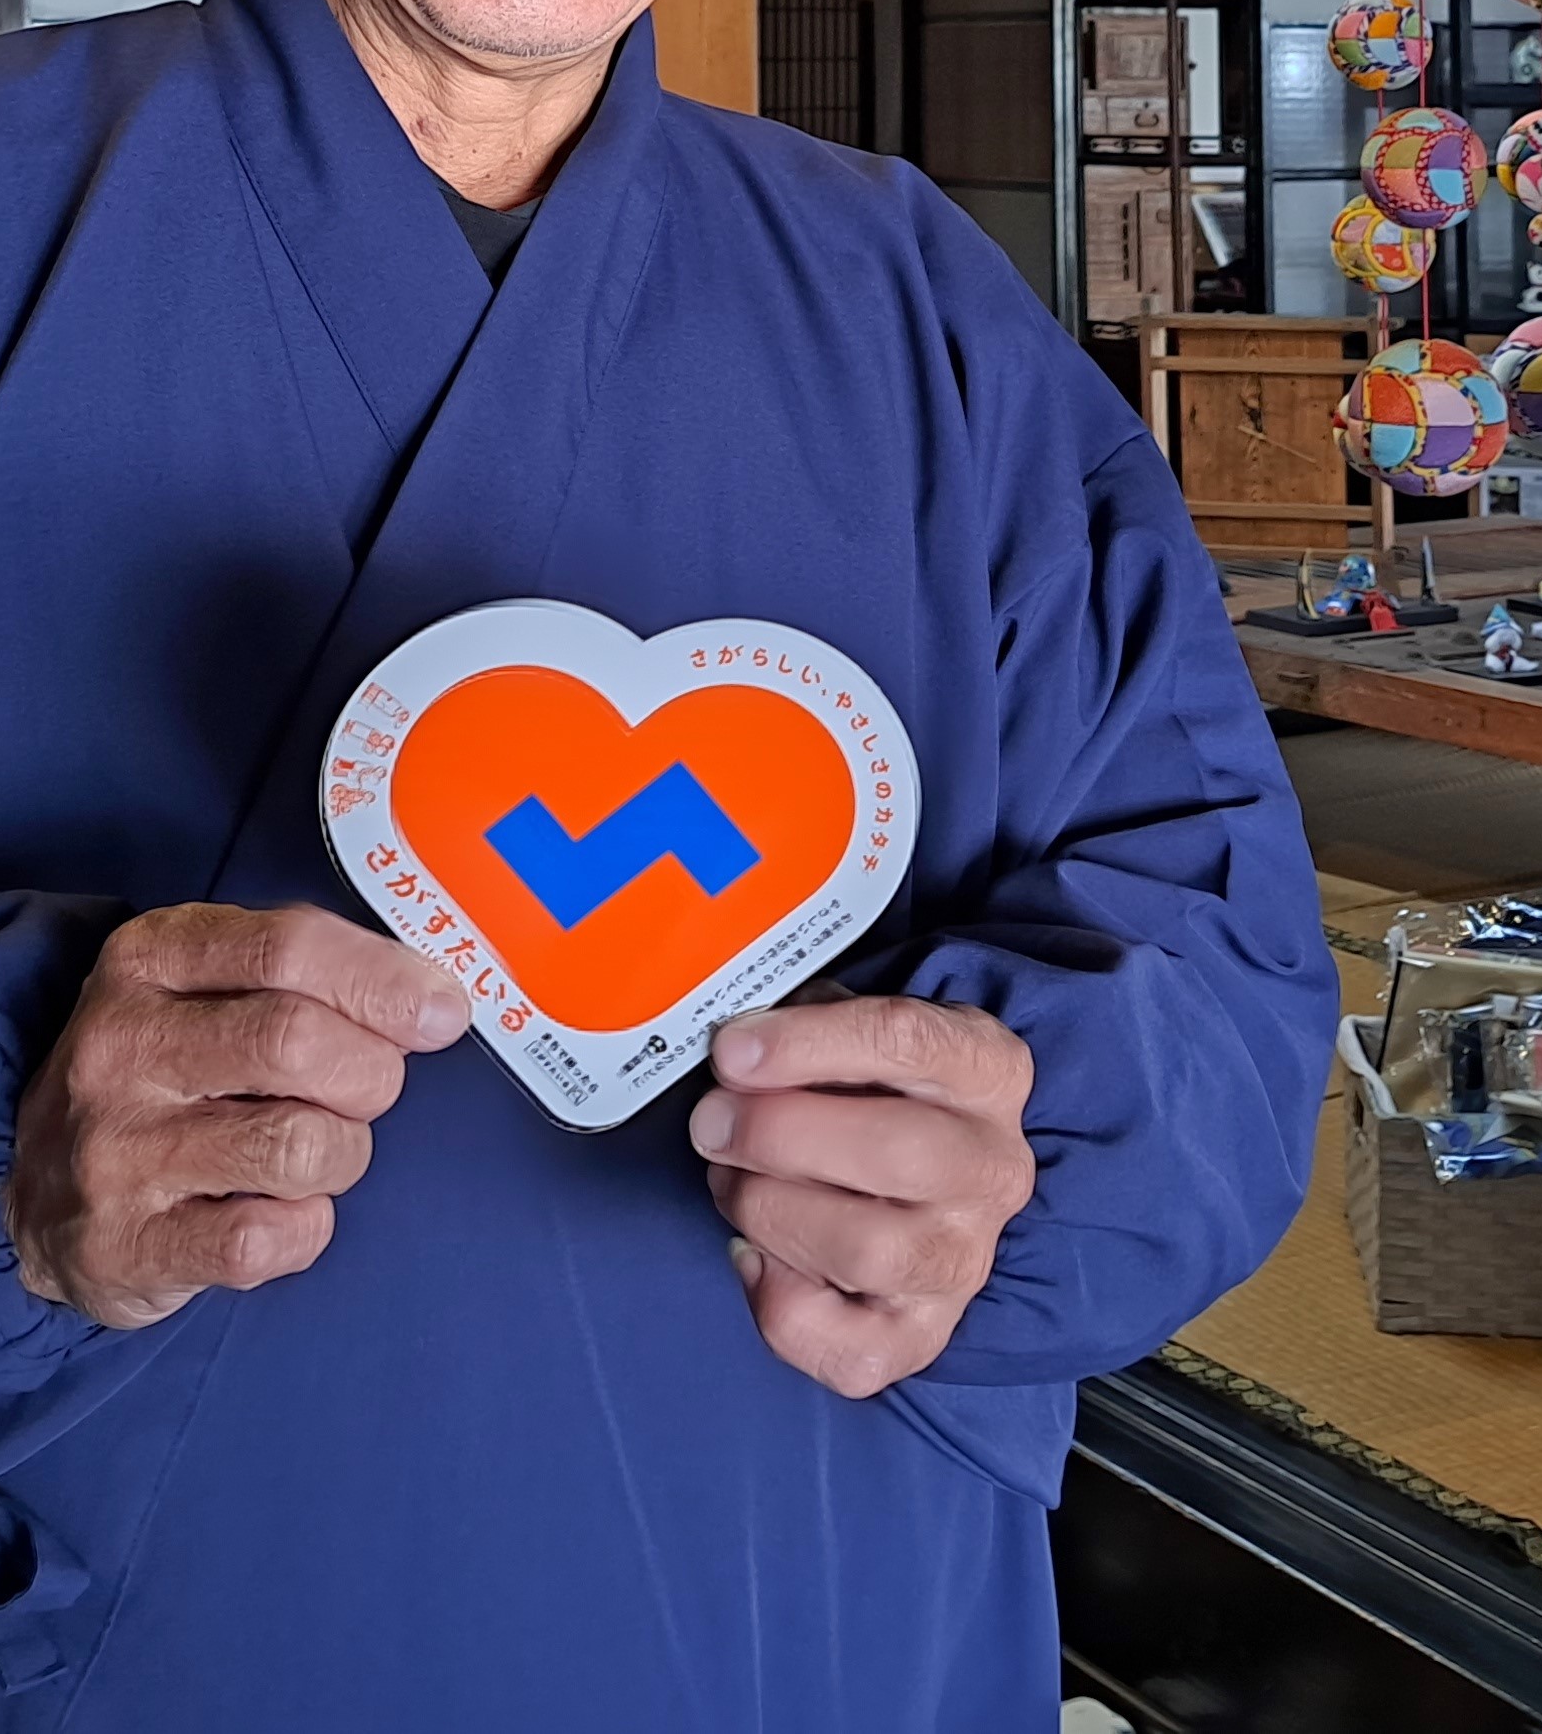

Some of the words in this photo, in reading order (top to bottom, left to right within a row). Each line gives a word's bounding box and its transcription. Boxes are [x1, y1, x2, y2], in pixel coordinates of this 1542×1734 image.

[690, 645, 893, 872] さがらしい、やさしさのカタチ
[366, 842, 533, 1032] さがすたいる
